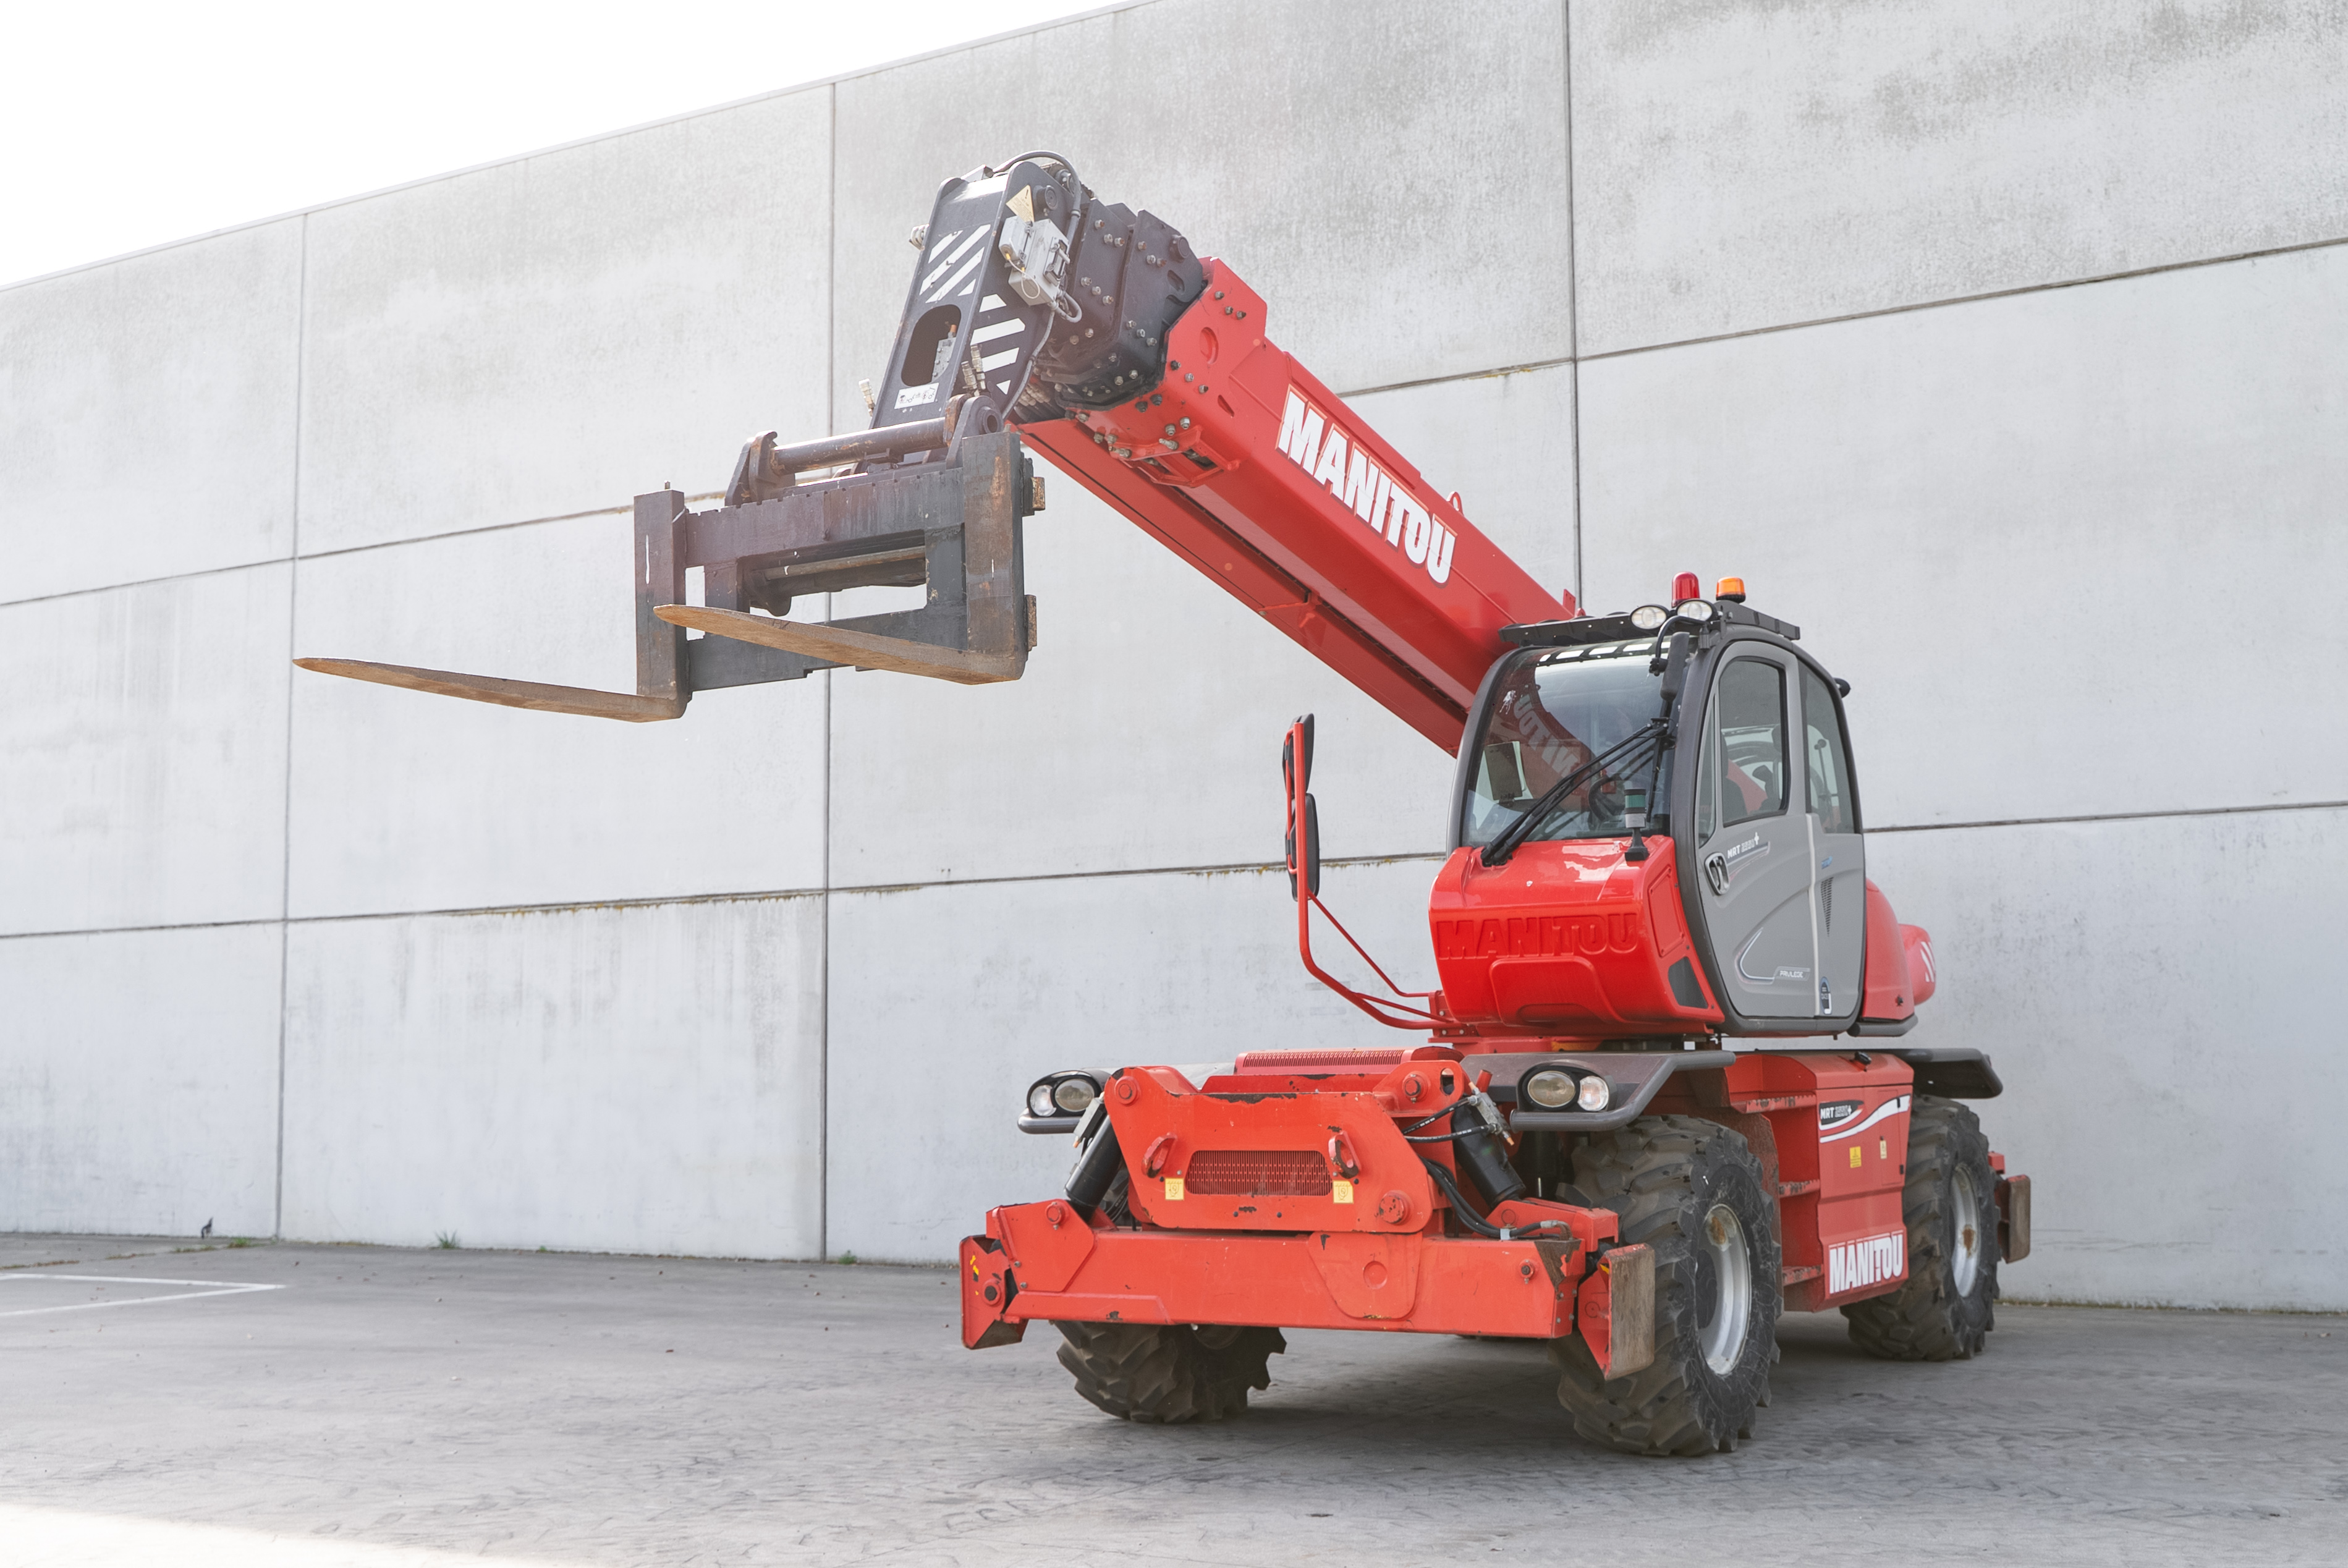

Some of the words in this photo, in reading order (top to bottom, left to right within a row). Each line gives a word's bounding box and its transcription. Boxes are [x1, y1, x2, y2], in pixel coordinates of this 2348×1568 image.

[1276, 386, 1457, 586] MANITOU
[1727, 844, 1740, 859] MRT
[1436, 913, 1639, 960] MANITOU
[1820, 1106, 1834, 1120] MRT
[1829, 1232, 1904, 1294] MANITOU
